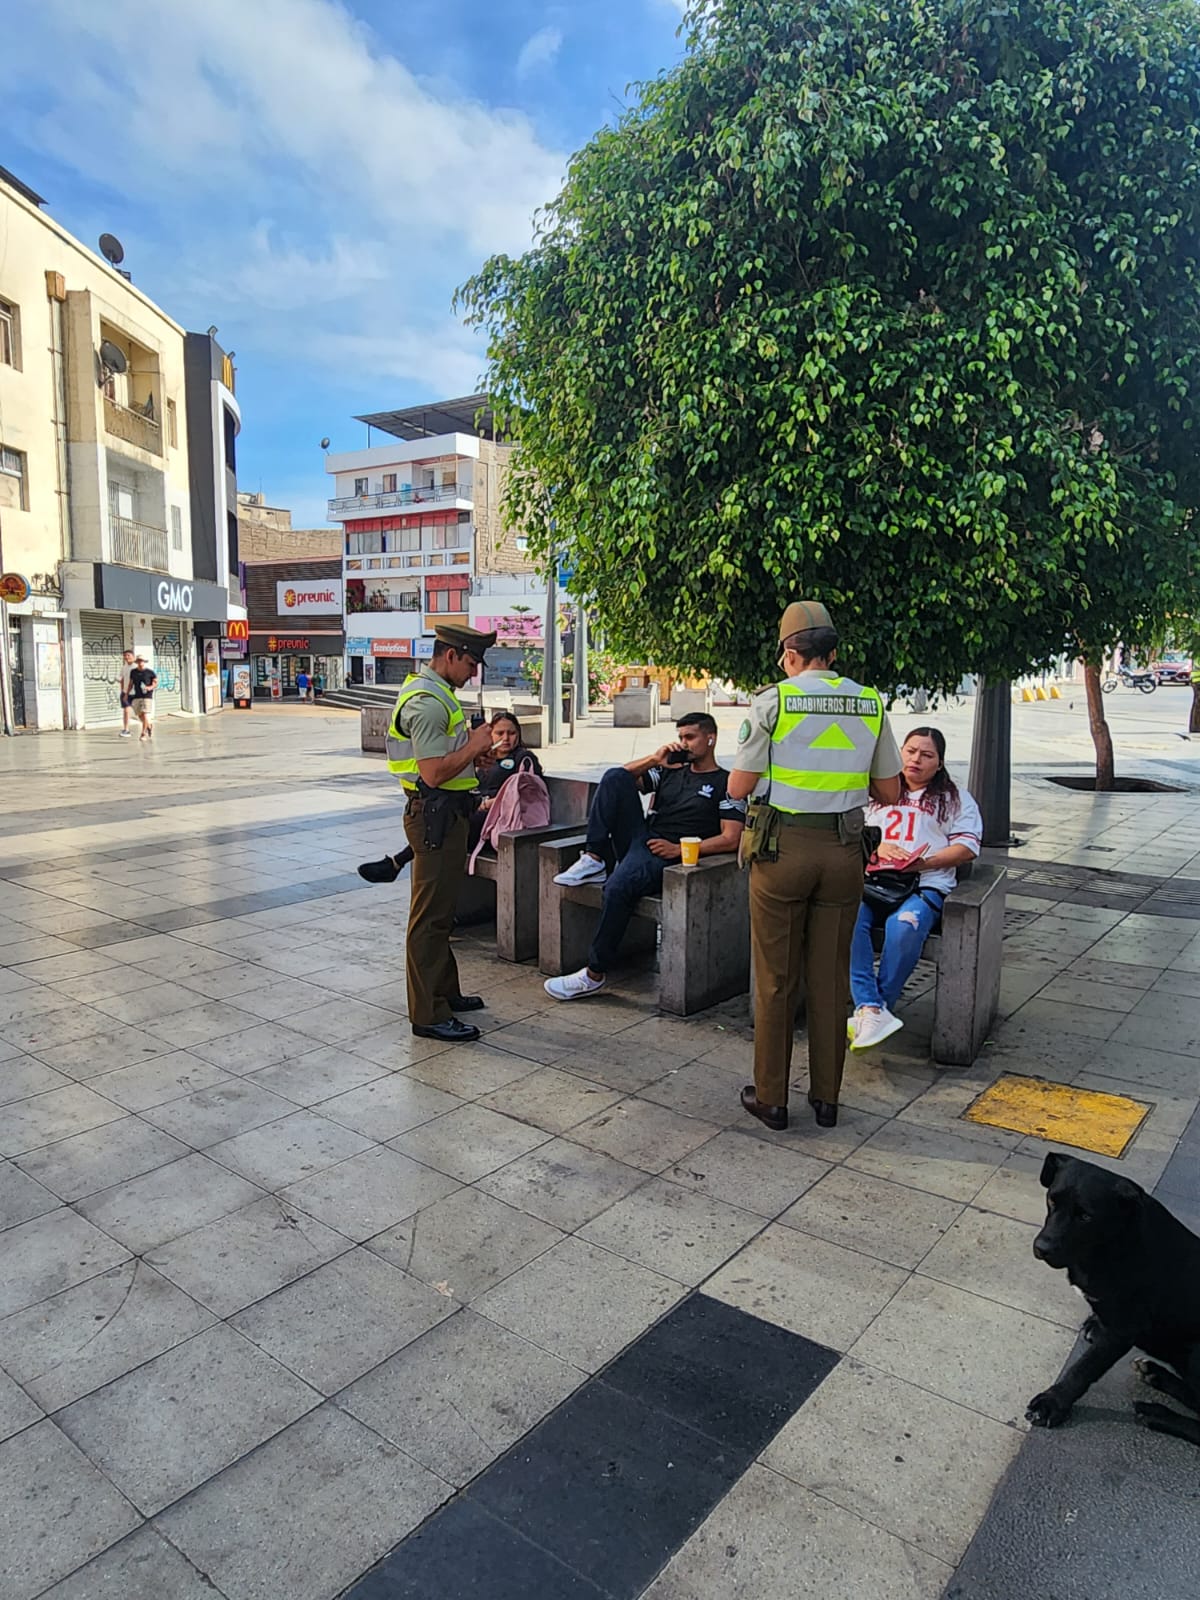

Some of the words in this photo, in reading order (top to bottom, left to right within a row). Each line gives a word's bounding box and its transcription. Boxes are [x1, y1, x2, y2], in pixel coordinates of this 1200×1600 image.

[158, 581, 192, 613] GMO
[297, 589, 335, 605] preunic
[277, 637, 309, 651] preunic
[786, 696, 844, 713] CARABINEROS
[845, 698, 856, 713] DE
[857, 699, 877, 715] CHILE
[885, 809, 916, 841] 21
